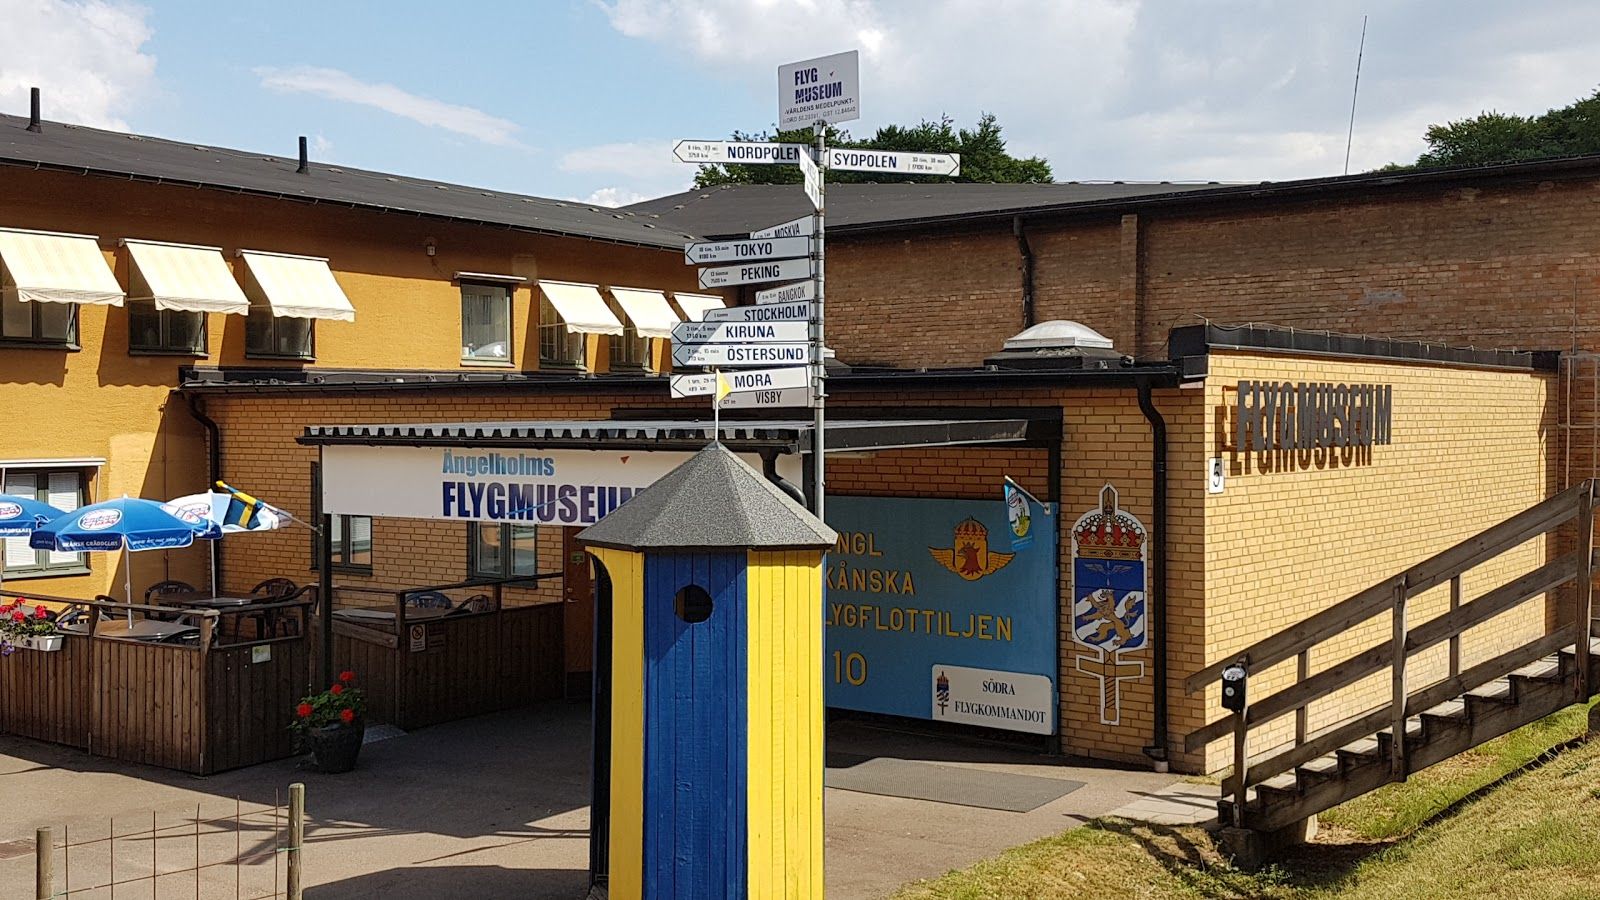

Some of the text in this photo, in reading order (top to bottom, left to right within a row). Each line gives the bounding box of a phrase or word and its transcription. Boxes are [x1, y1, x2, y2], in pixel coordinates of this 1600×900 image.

[795, 67, 818, 86] FLYG
[795, 81, 842, 104] MUSEUM
[727, 146, 800, 160] NORDPOLEN
[834, 152, 897, 169] SYDPOLEN
[774, 223, 800, 238] MOSKVA
[734, 242, 773, 257] TOKYO
[741, 264, 780, 280] PEKING
[778, 286, 806, 301] BANGKOK
[744, 305, 807, 321] STOCKHOLM
[726, 325, 775, 338] KIRUNA
[727, 345, 804, 361] ÖSTERSUND
[734, 373, 772, 388] MORA
[755, 391, 782, 404] VISBY
[1237, 380, 1393, 453] FLYGMUSEUM
[442, 449, 555, 477] Ängelholms
[1212, 462, 1221, 488] 5
[826, 531, 882, 557] NGL
[826, 560, 916, 596] KÅNSKA
[833, 650, 868, 687] 10
[982, 678, 1016, 696] SÖDRA
[954, 700, 1047, 724] FLYGKOMMANDOT
